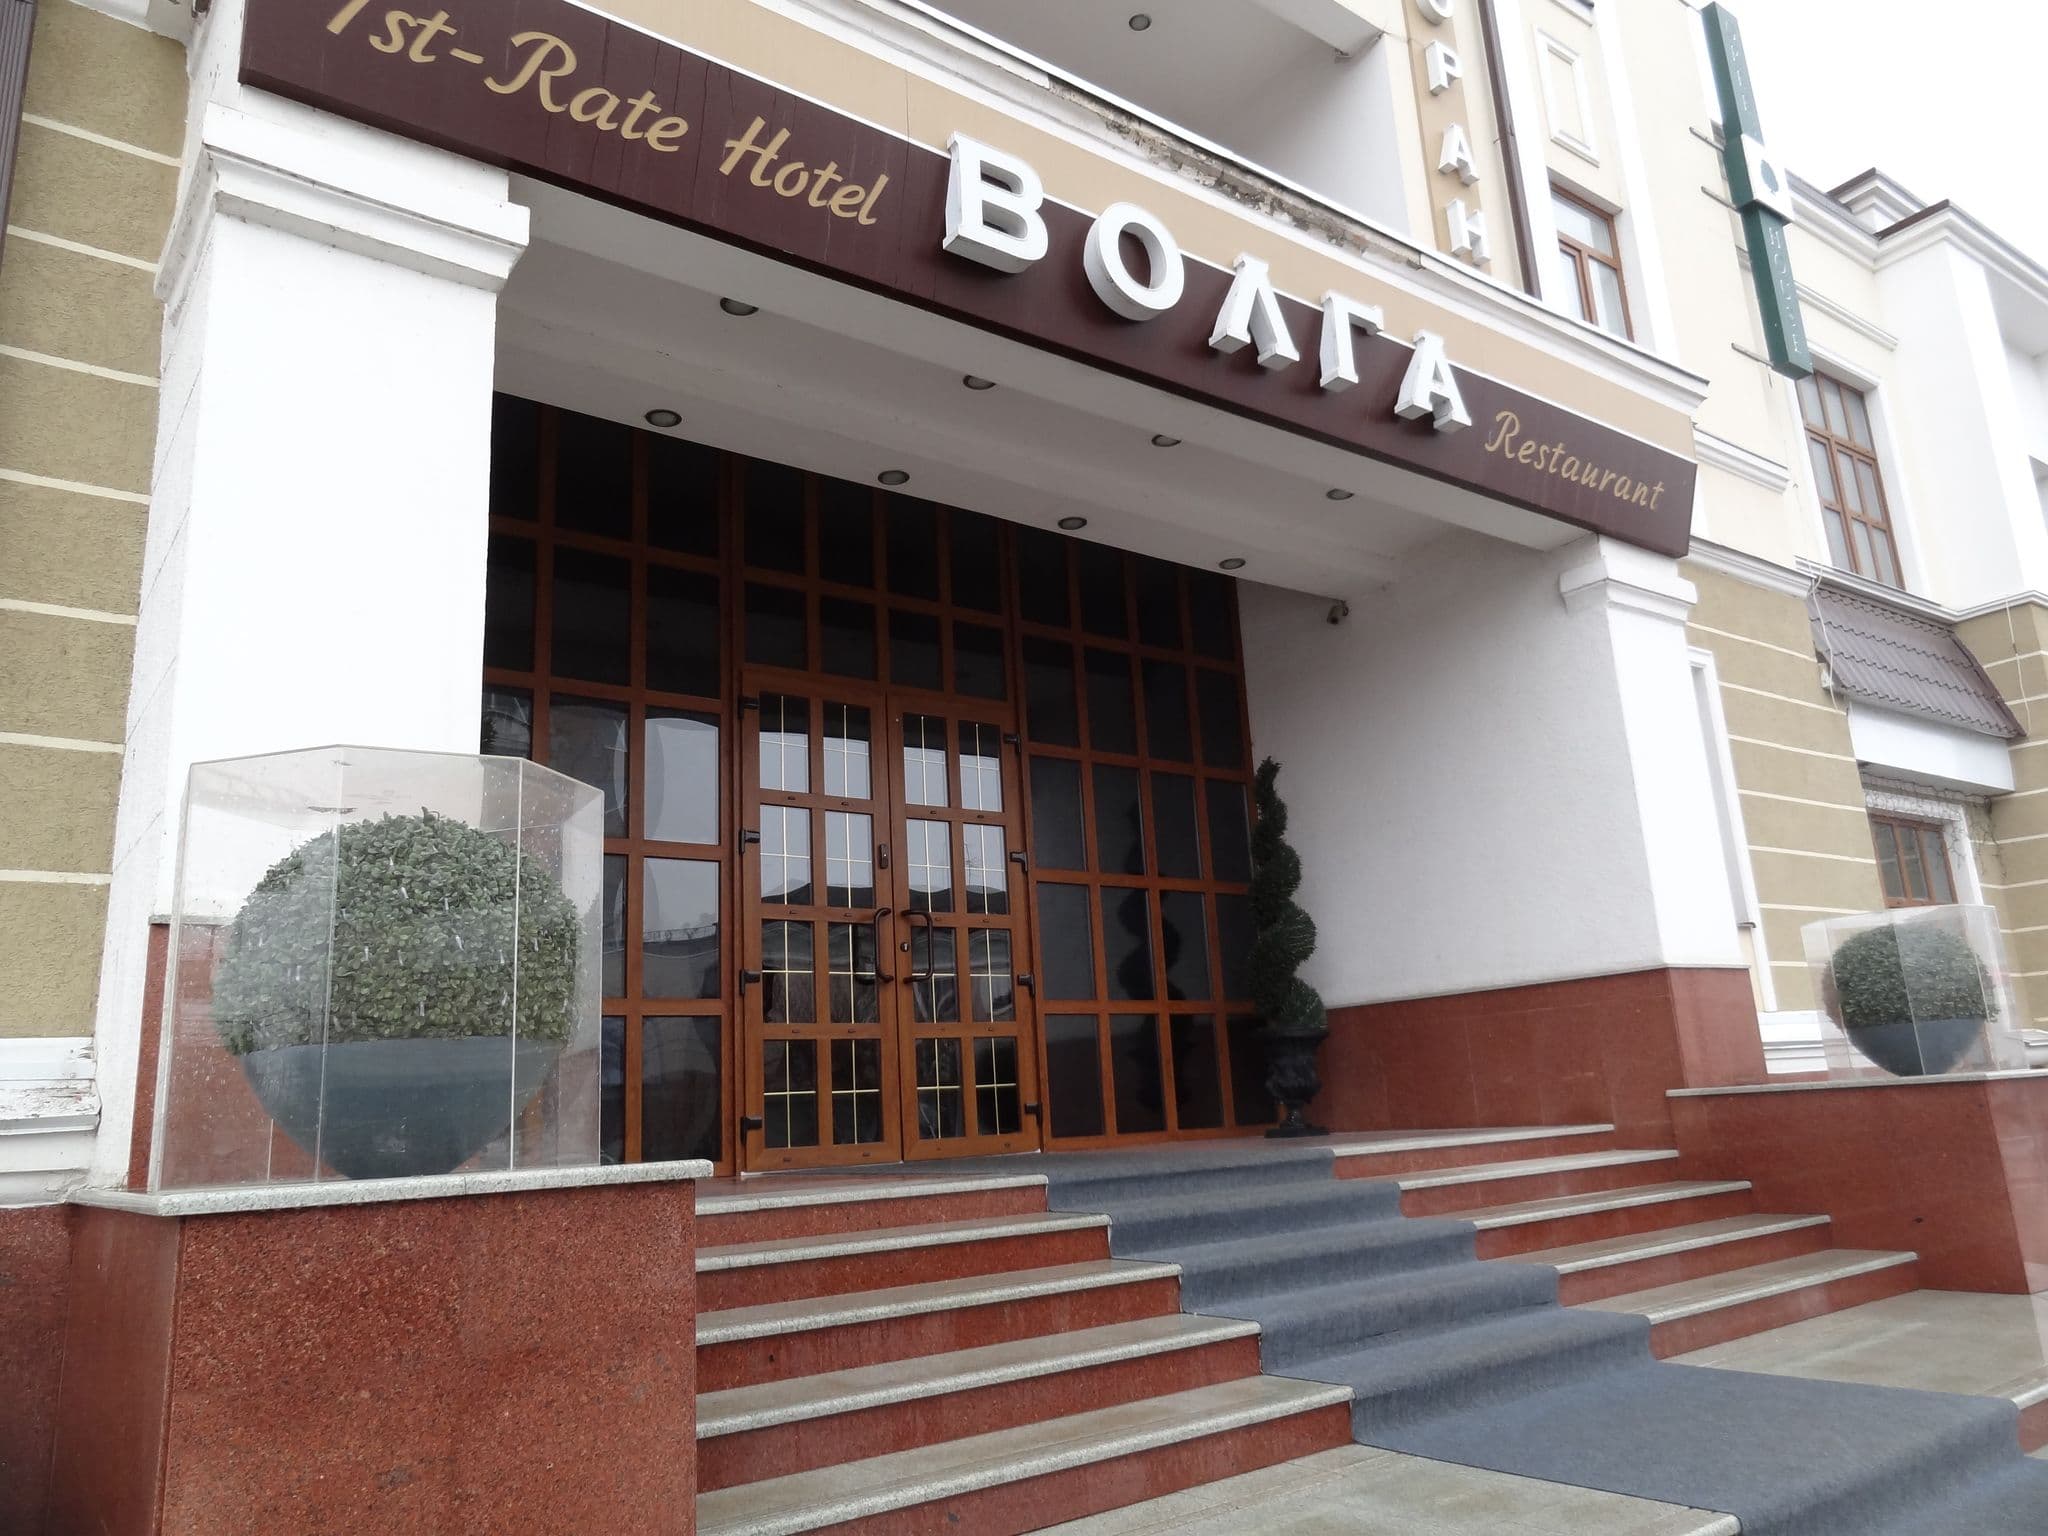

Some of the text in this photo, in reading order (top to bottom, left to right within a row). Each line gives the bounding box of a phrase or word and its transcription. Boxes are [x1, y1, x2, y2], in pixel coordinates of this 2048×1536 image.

[718, 116, 890, 226] Hotel
[942, 131, 1472, 434] ВОЛГА
[1484, 410, 1665, 511] Restaurant
